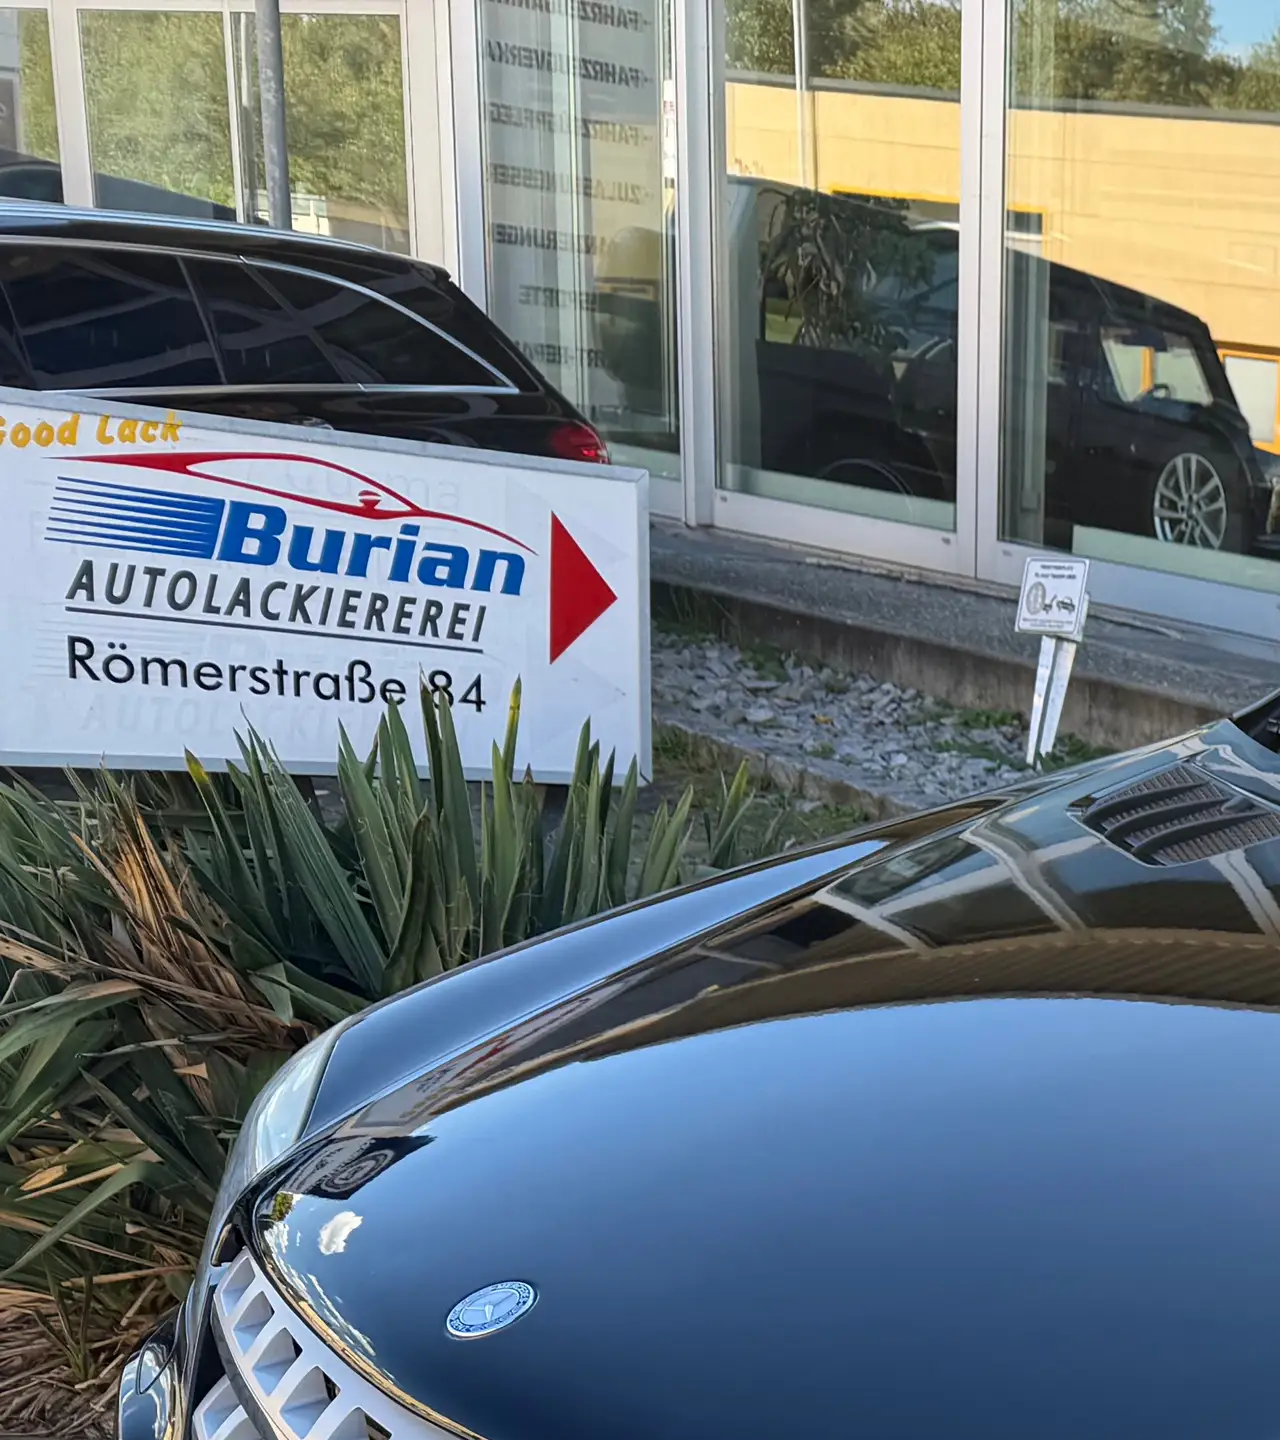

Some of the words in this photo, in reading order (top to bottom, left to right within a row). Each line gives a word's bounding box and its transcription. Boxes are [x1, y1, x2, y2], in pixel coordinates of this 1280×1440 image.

[96, 411, 183, 445] Lack
[217, 499, 526, 596] Burian
[66, 559, 487, 642] AUTOLACKIEREREI
[66, 635, 406, 705] Römerstraße
[428, 670, 486, 712] 84
